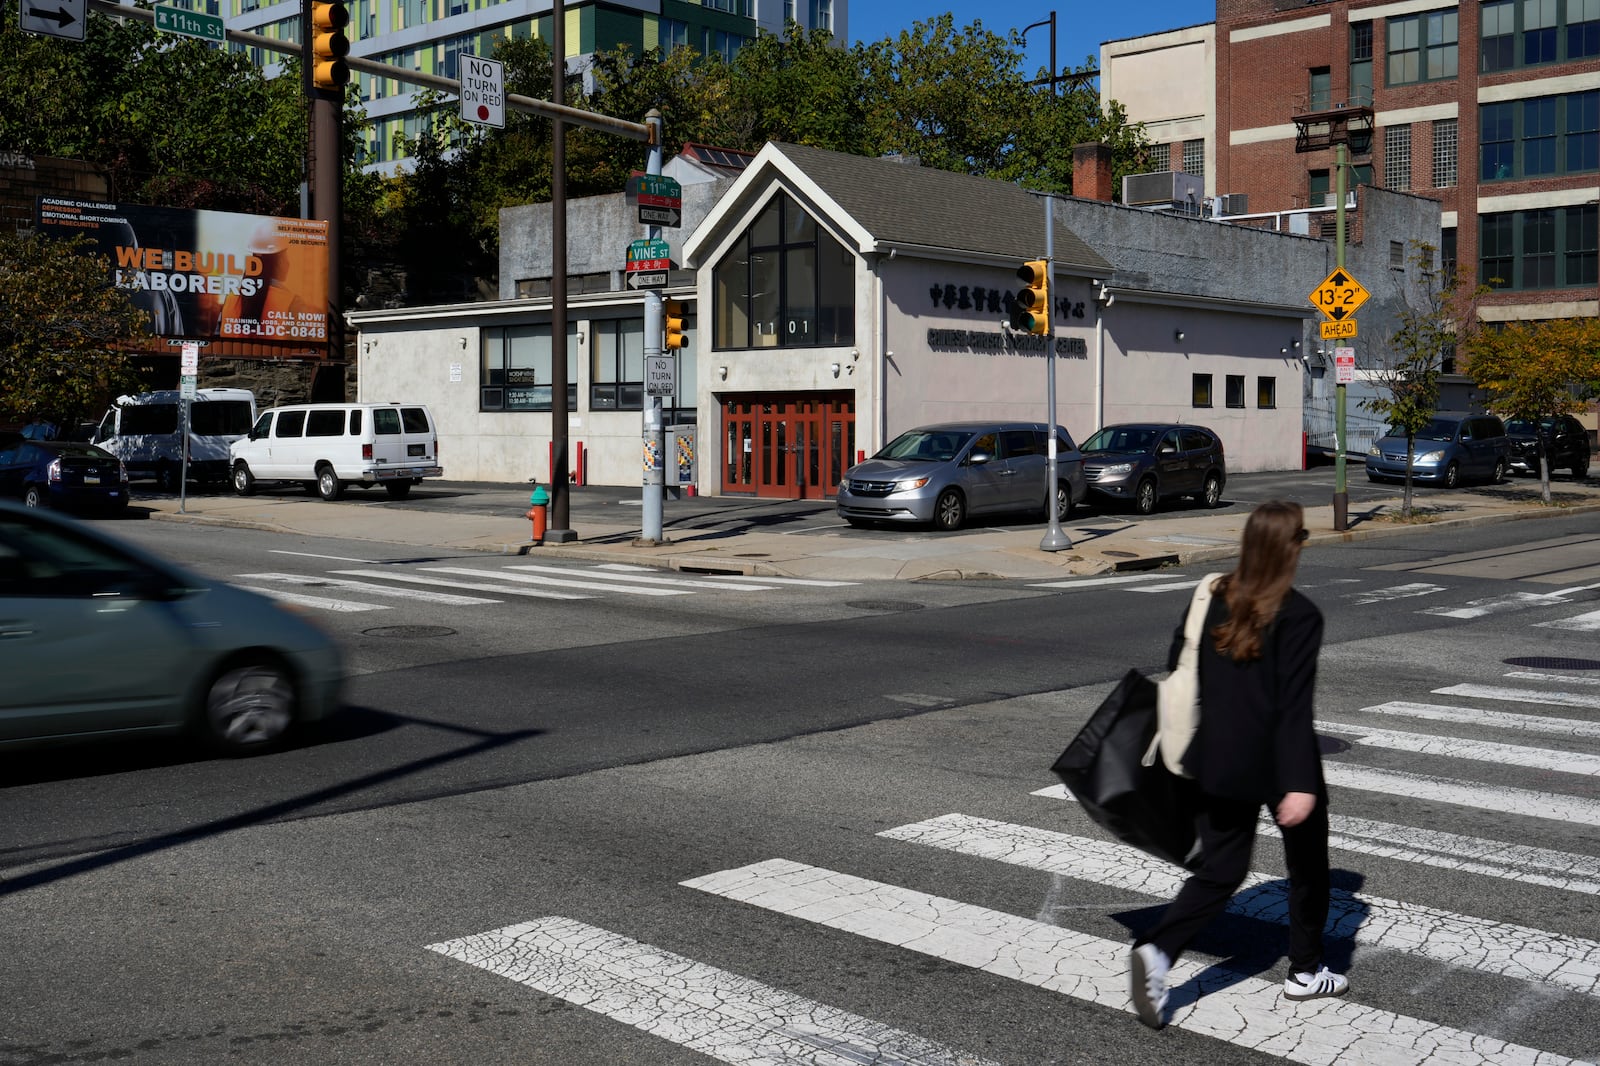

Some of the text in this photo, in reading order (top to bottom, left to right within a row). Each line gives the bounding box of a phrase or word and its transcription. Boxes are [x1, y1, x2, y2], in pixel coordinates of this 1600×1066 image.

[171, 13, 222, 37] 11th St
[470, 60, 493, 78] NO
[467, 77, 497, 93] TURN
[464, 90, 501, 107] ON RED
[670, 188, 679, 197] ST
[42, 198, 116, 210] ACADEMIC CHALLENGES
[42, 205, 81, 214] DEPRESSION
[42, 211, 127, 224] EMOTIONAL SHORTCOMINGS
[643, 210, 669, 220] ONE WAY
[633, 246, 669, 260] VINE ST
[116, 246, 263, 277] WE BUILD
[115, 270, 263, 297] LABORERS'
[639, 275, 664, 285] ONE WAY
[267, 311, 326, 322] CALL NOW!
[223, 323, 325, 339] 888-LDC-0848
[1324, 323, 1353, 336] AHEAD
[655, 361, 667, 370] NO
[651, 371, 672, 381] TURN
[648, 382, 674, 391] ON RED
